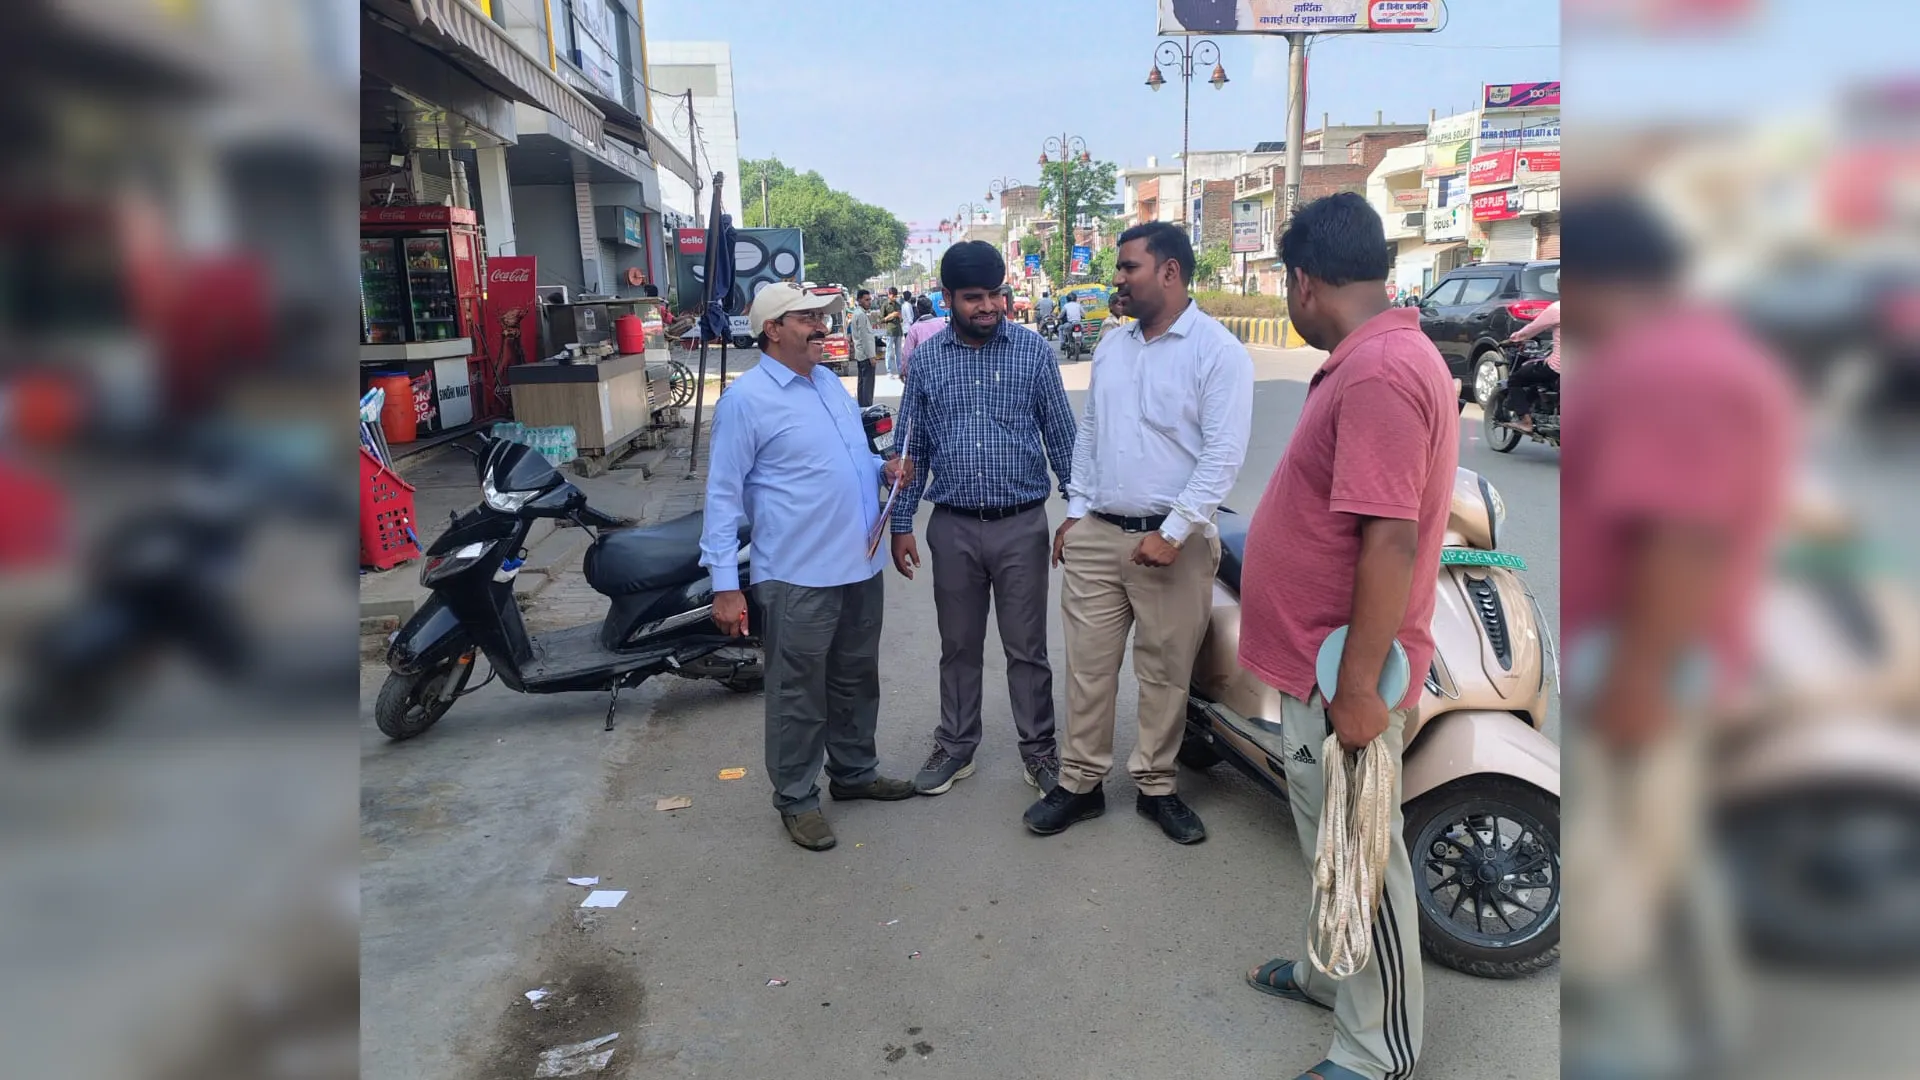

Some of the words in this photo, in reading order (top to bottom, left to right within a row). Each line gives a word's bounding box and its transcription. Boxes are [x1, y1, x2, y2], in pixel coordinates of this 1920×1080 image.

[1294, 2, 1323, 13] हार्दिक
[1286, 14, 1300, 24] एवं
[1435, 131, 1452, 142] ALPHA
[1453, 128, 1471, 139] SOLAR
[1488, 195, 1504, 207] PLUS
[680, 235, 704, 244] cello
[1293, 754, 1316, 764] adidas
